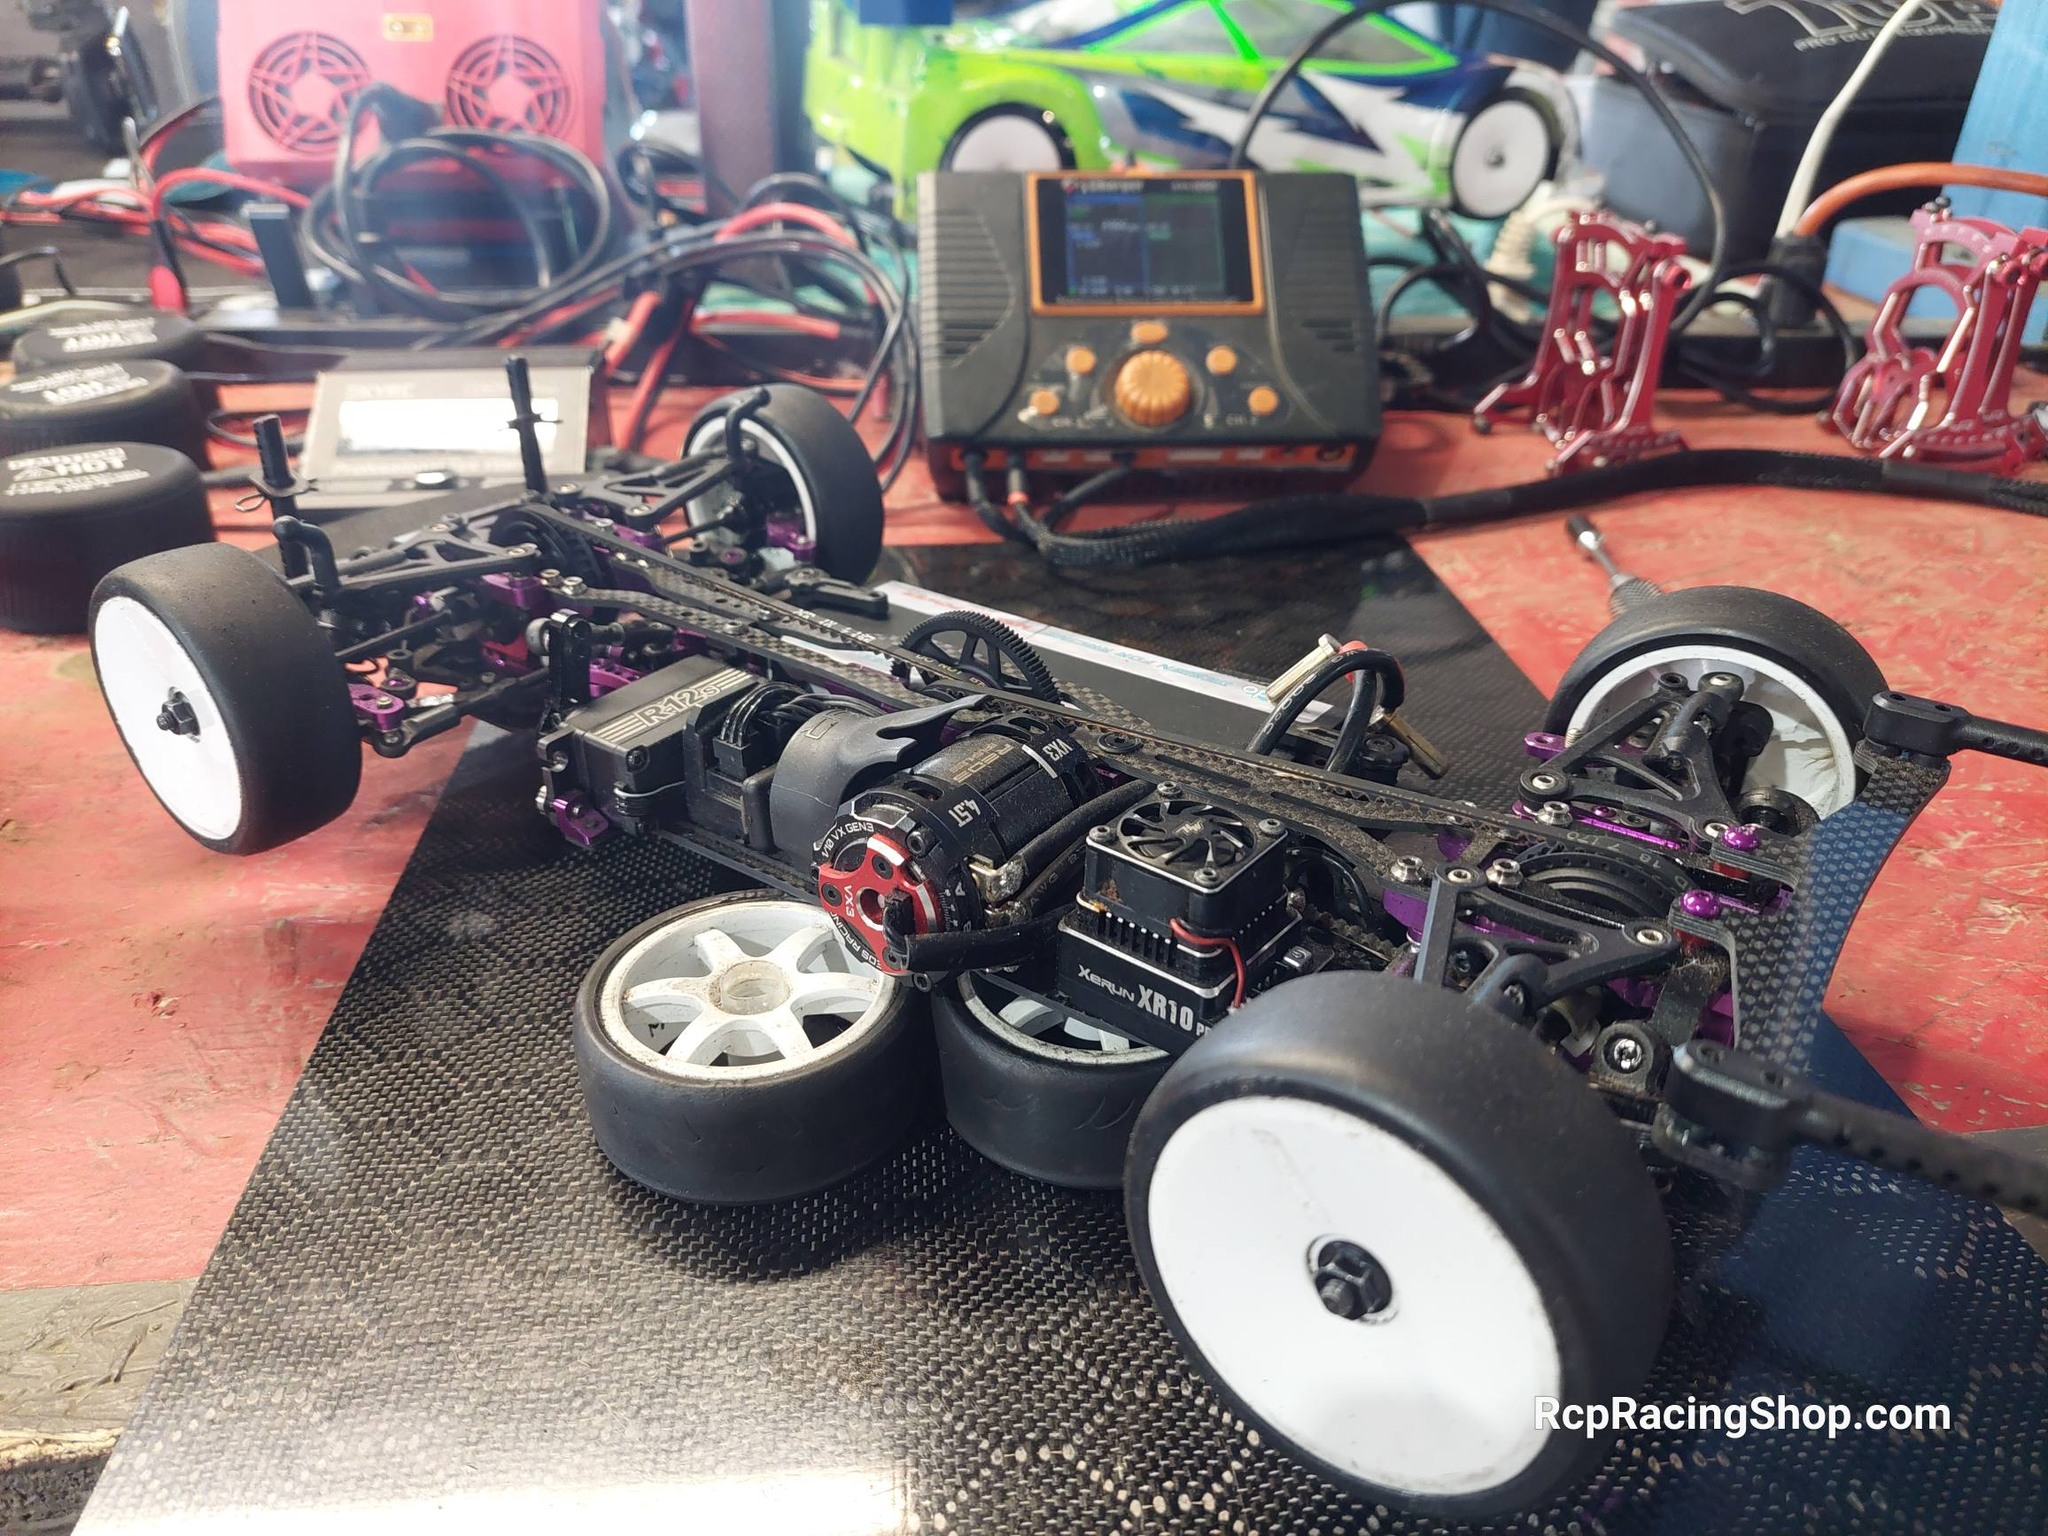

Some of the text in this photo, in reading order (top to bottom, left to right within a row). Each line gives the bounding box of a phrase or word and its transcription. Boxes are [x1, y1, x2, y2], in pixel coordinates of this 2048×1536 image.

[845, 820, 875, 833] GEN3
[843, 885, 855, 918] VX3
[1137, 984, 1193, 1031] XR10
